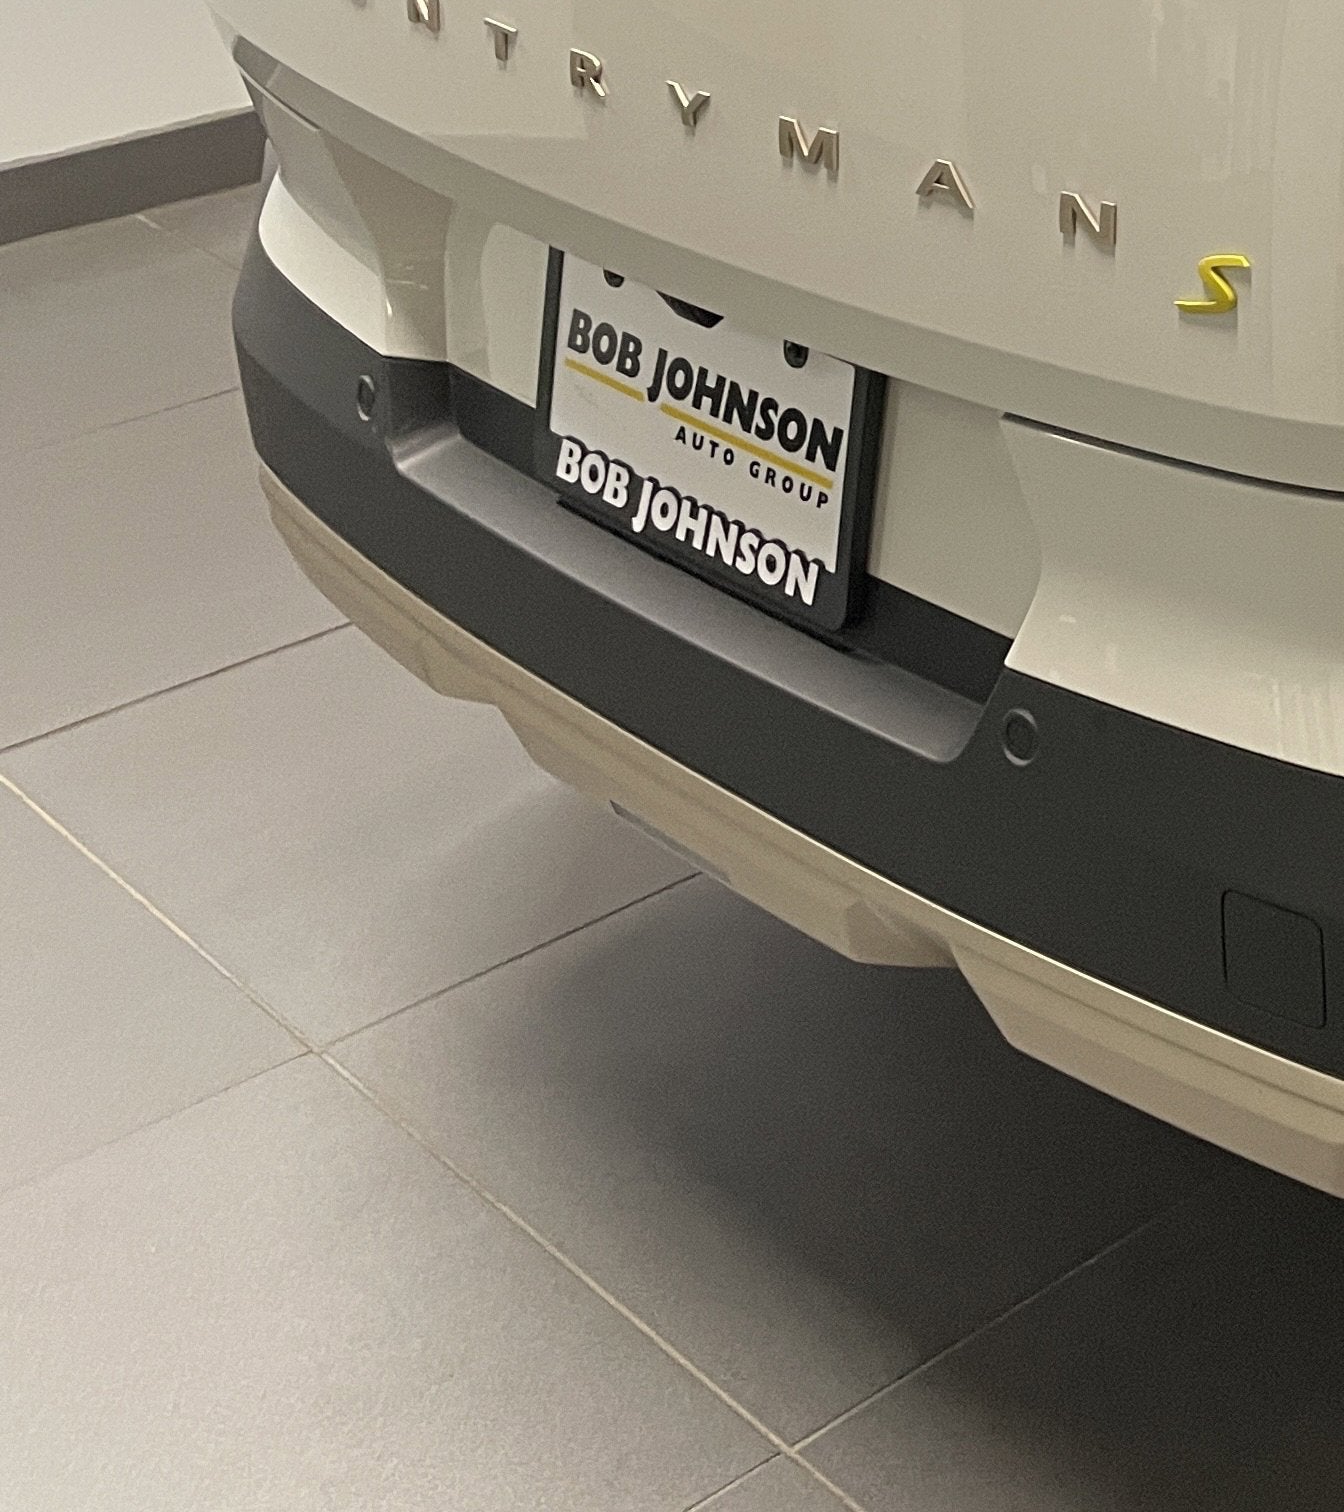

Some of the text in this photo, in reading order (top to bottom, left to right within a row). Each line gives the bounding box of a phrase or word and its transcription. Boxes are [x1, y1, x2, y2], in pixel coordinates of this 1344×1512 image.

[1174, 252, 1251, 315] S
[566, 307, 845, 473] BOB JOHNSON
[555, 437, 821, 607] BOB JOHNSON
[674, 424, 830, 510] AUTO GROUP
